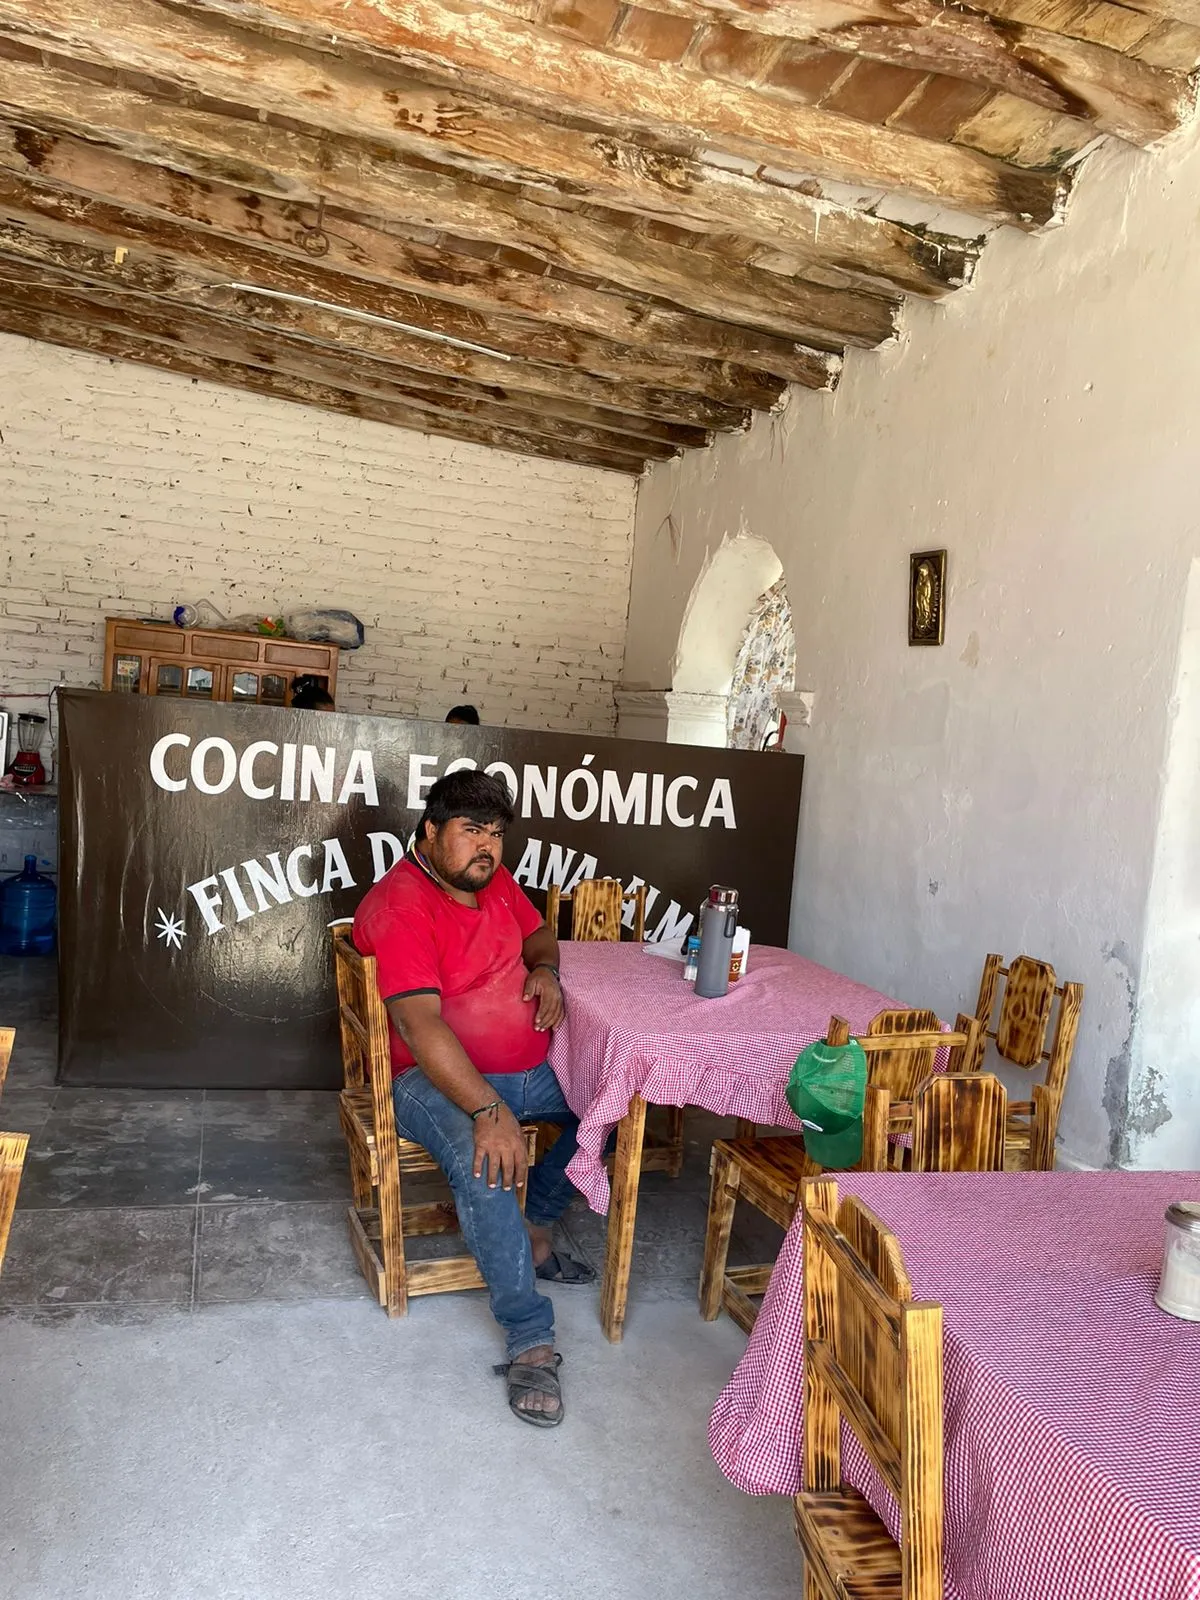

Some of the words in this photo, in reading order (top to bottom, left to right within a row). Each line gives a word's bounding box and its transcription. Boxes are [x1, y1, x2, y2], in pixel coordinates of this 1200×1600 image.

[150, 733, 380, 806] COCINA
[187, 837, 357, 936] FINCA
[512, 837, 598, 893] ANA
[619, 874, 695, 943] ALM
